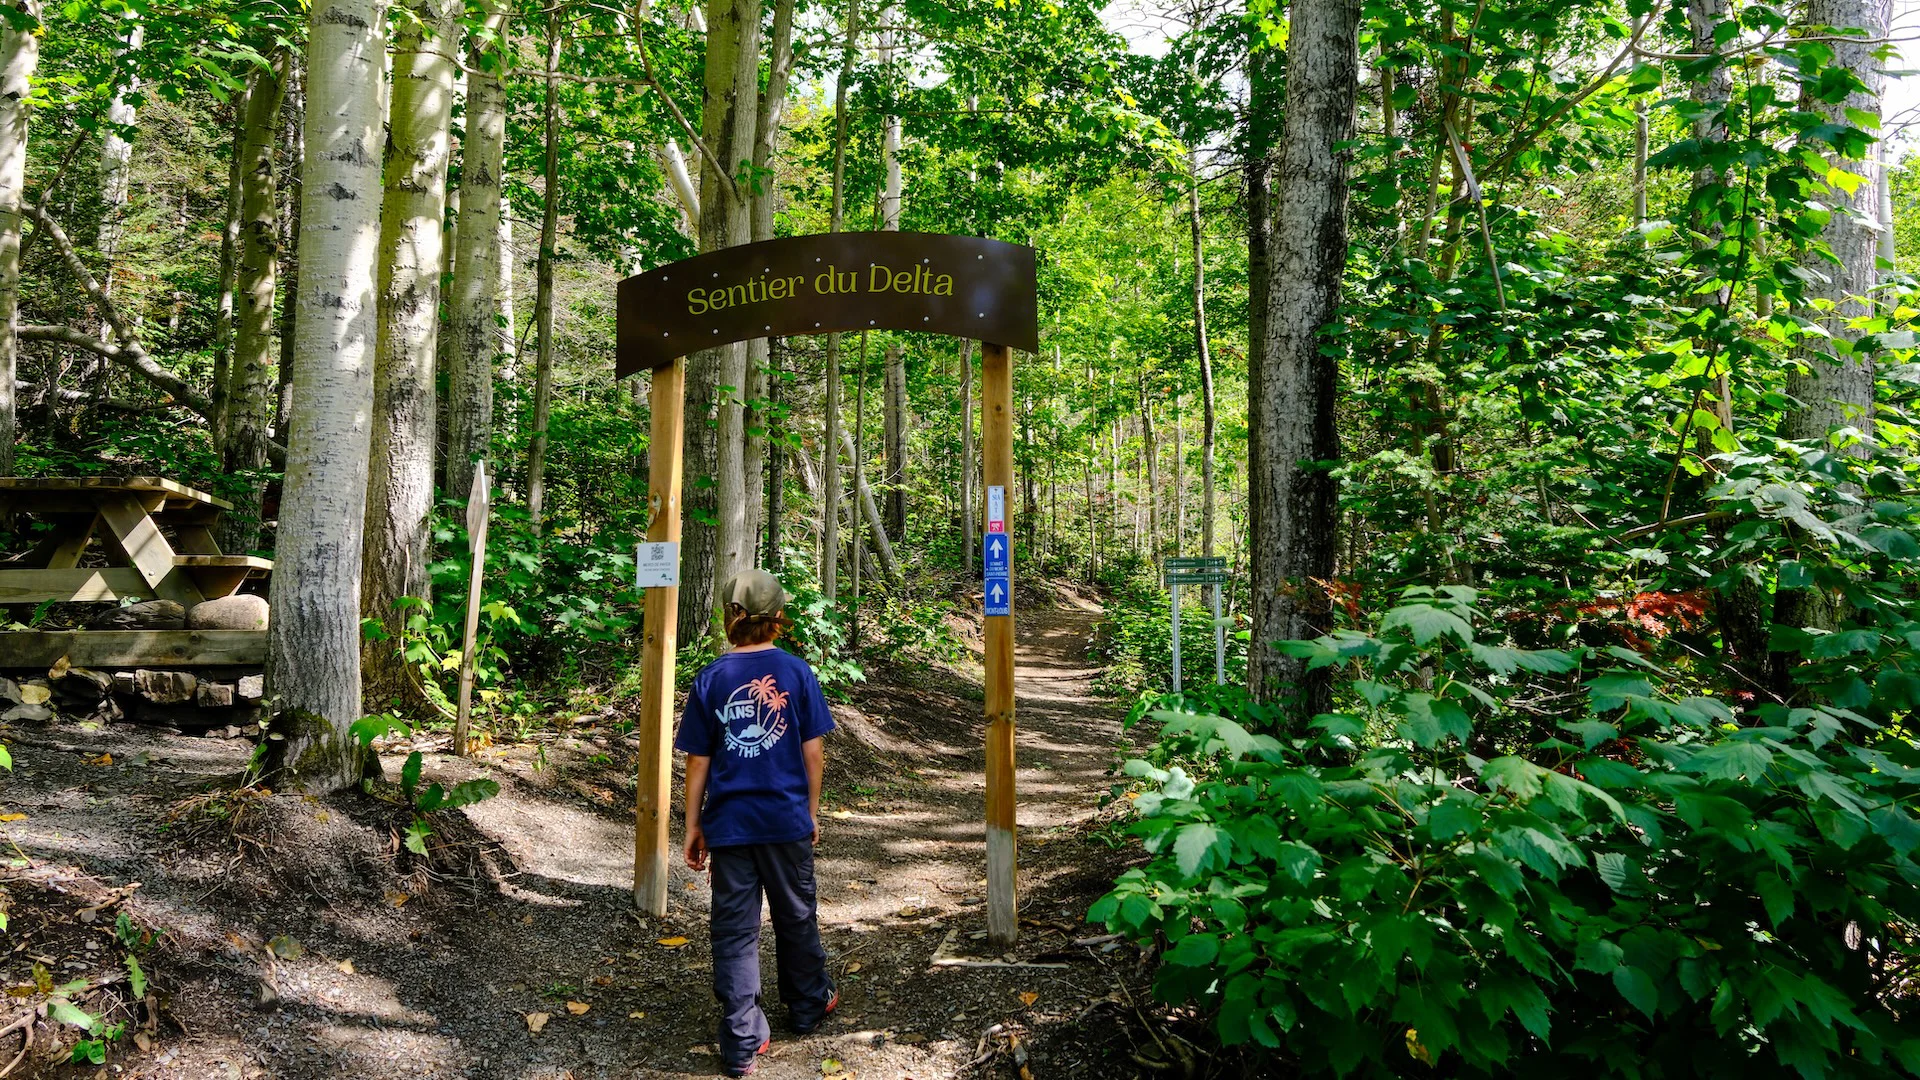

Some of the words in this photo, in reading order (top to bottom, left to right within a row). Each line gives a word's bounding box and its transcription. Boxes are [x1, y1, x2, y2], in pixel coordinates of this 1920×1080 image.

[687, 275, 804, 316] Sentier
[814, 265, 857, 295] du
[868, 264, 954, 296] Delta
[715, 699, 756, 724] VANS
[738, 744, 761, 758] THE
